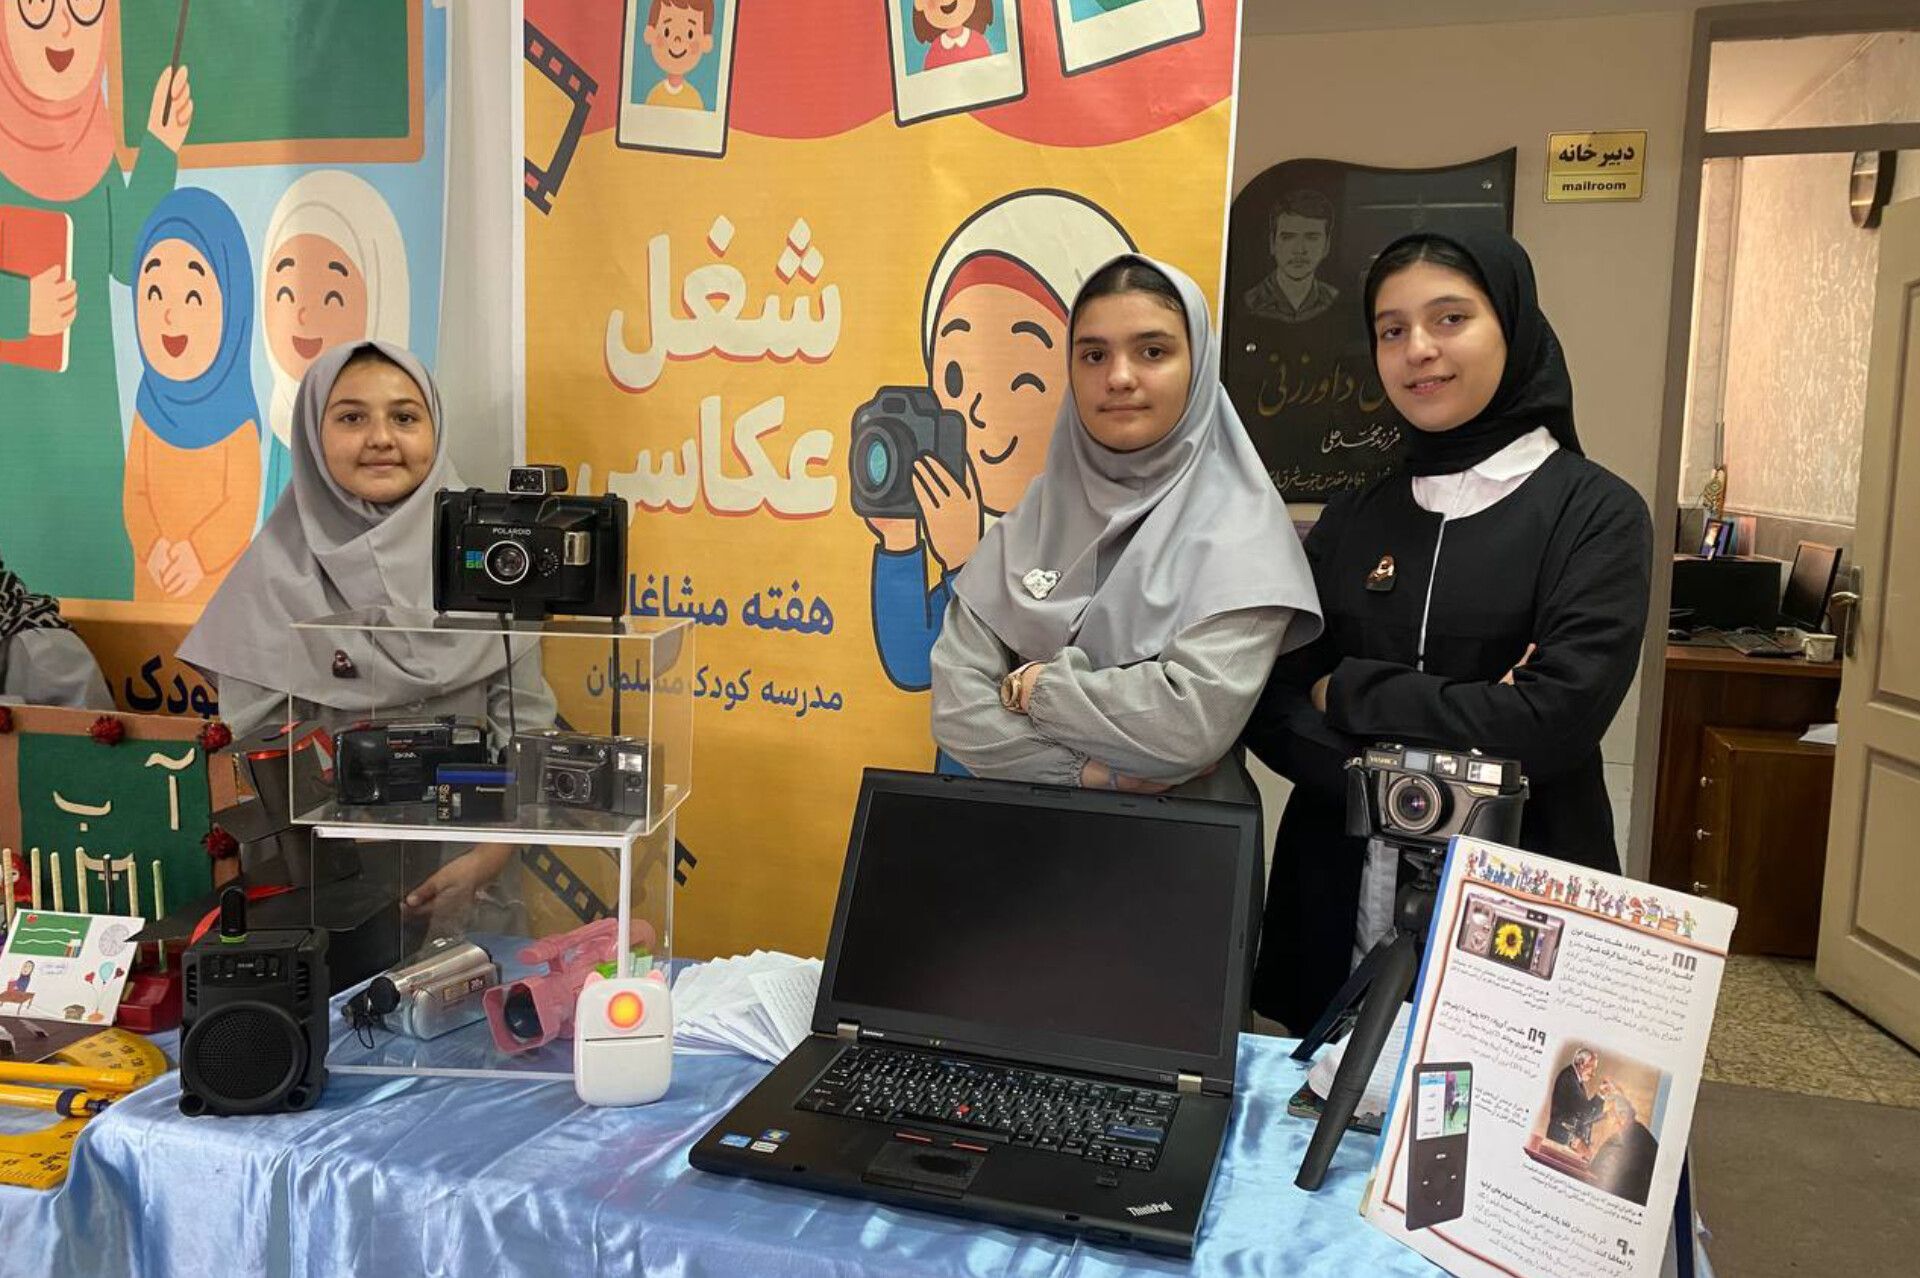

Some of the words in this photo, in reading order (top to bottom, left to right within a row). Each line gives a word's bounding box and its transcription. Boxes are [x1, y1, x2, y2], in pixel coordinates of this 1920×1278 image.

[1559, 144, 1635, 168] دبیرخانه
[1562, 181, 1627, 191] mailroom
[605, 215, 841, 394] شغل
[493, 527, 531, 536] POLAROID
[742, 579, 834, 636] هفته
[126, 655, 219, 719] ودک
[694, 665, 751, 711] کودک
[762, 676, 843, 717] مدرسه
[53, 791, 111, 832] ب
[1125, 1201, 1173, 1217] ThinkPad
